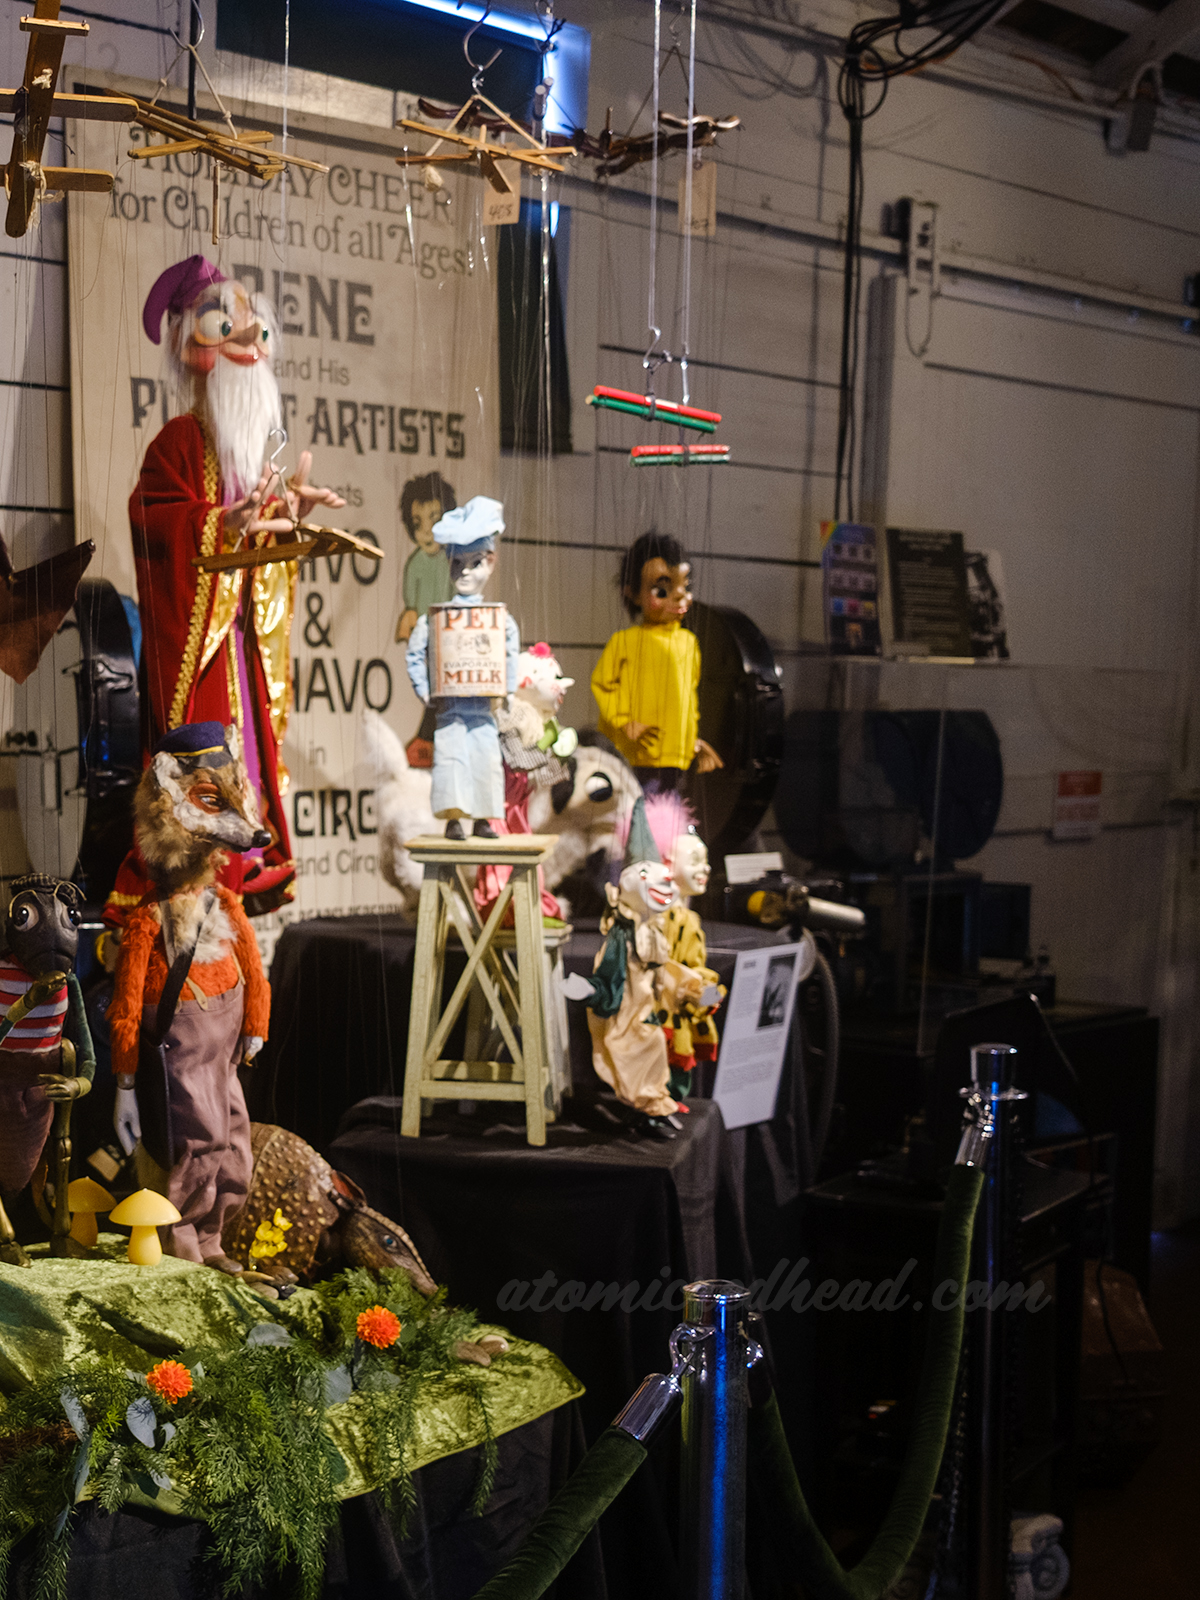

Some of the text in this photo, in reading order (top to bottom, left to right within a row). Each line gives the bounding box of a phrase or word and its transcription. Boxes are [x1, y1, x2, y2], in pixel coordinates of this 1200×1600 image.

[328, 164, 453, 226] CHEER
[110, 177, 473, 279] for Chldren of all Ages!
[274, 356, 350, 386] and His
[307, 397, 467, 460] ARTISTS
[304, 592, 332, 648] &
[441, 607, 501, 631] PET
[443, 669, 502, 685] MILK
[309, 741, 327, 765] in
[294, 788, 378, 841] CIRC
[296, 849, 378, 876] and Cirq
